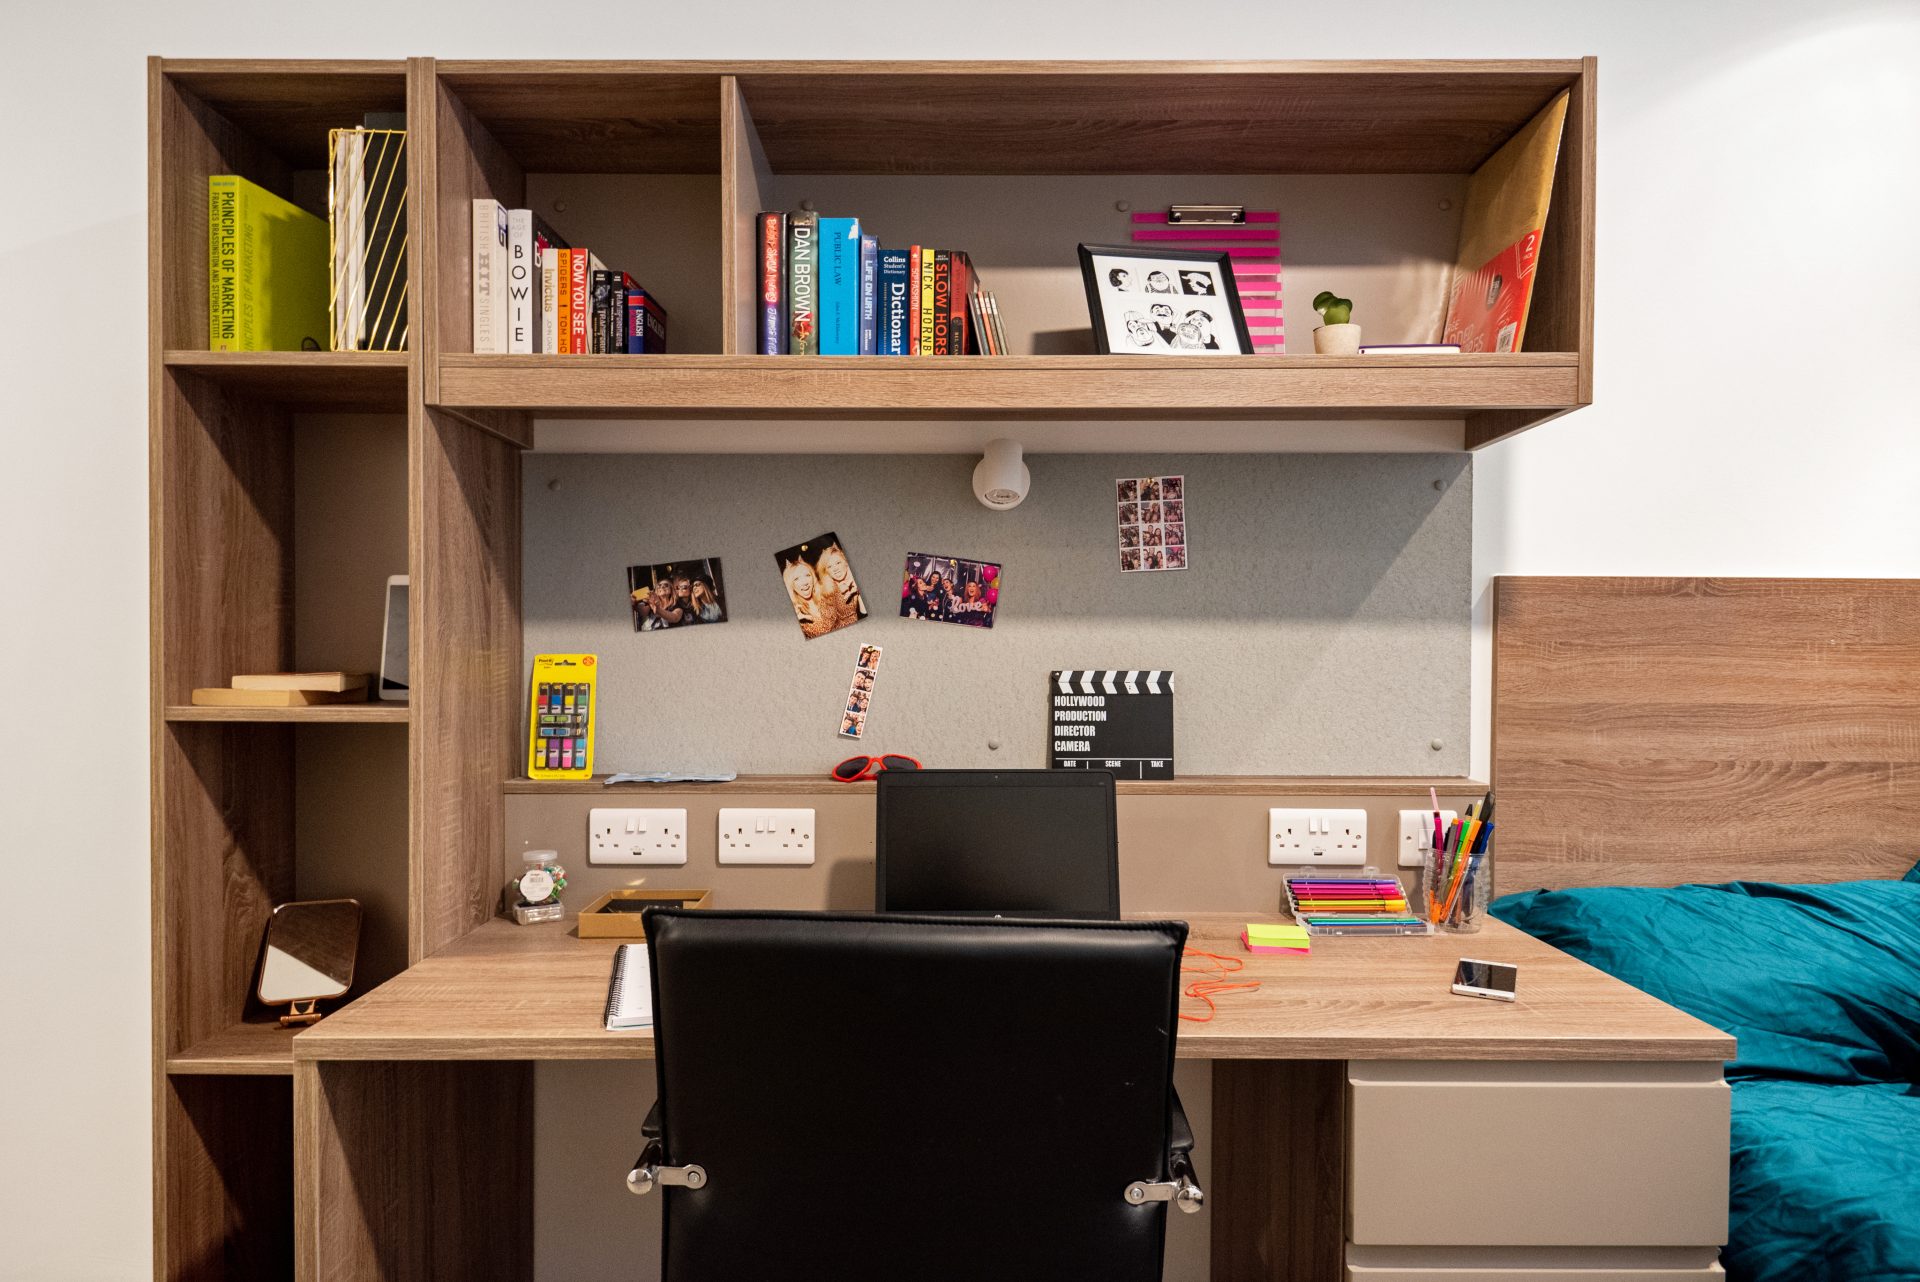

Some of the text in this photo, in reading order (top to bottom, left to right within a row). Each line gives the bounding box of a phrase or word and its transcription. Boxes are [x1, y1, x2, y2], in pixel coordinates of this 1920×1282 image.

[211, 192, 220, 221] FRANCES
[222, 192, 234, 255] PRINCIPLES
[479, 204, 489, 250] BRITISH
[211, 223, 220, 267] BRASSINGTON
[1525, 234, 1536, 252] 2
[222, 261, 234, 273] OF
[479, 252, 490, 296] HIT
[573, 254, 585, 283] NOW
[833, 232, 842, 286] PUBLIC LAW
[865, 260, 873, 282] LIFE
[211, 270, 220, 283] AND
[794, 228, 811, 322] DAN BROWN
[865, 282, 873, 296] ON
[936, 263, 948, 308] SLOW
[211, 285, 220, 313] STEPHEN
[510, 244, 529, 342] BOWIE
[544, 269, 555, 313] Invictus
[560, 252, 568, 354] SPIDERS TOM HO
[573, 284, 585, 311] YOU
[911, 280, 919, 310] FASHION
[222, 279, 234, 339] MARKETING
[479, 297, 490, 343] SINGLES
[573, 312, 585, 335] SEE
[635, 309, 644, 337] ENGLISH
[891, 282, 905, 355] Dictionar
[923, 262, 933, 355] NICK HORNB
[936, 314, 947, 355] HORS
[1054, 695, 1106, 707] HOLLYWOOD
[1054, 710, 1107, 721] PRODUCTION
[1054, 725, 1096, 737] DIRECTOR
[1054, 740, 1091, 752] CAMERA
